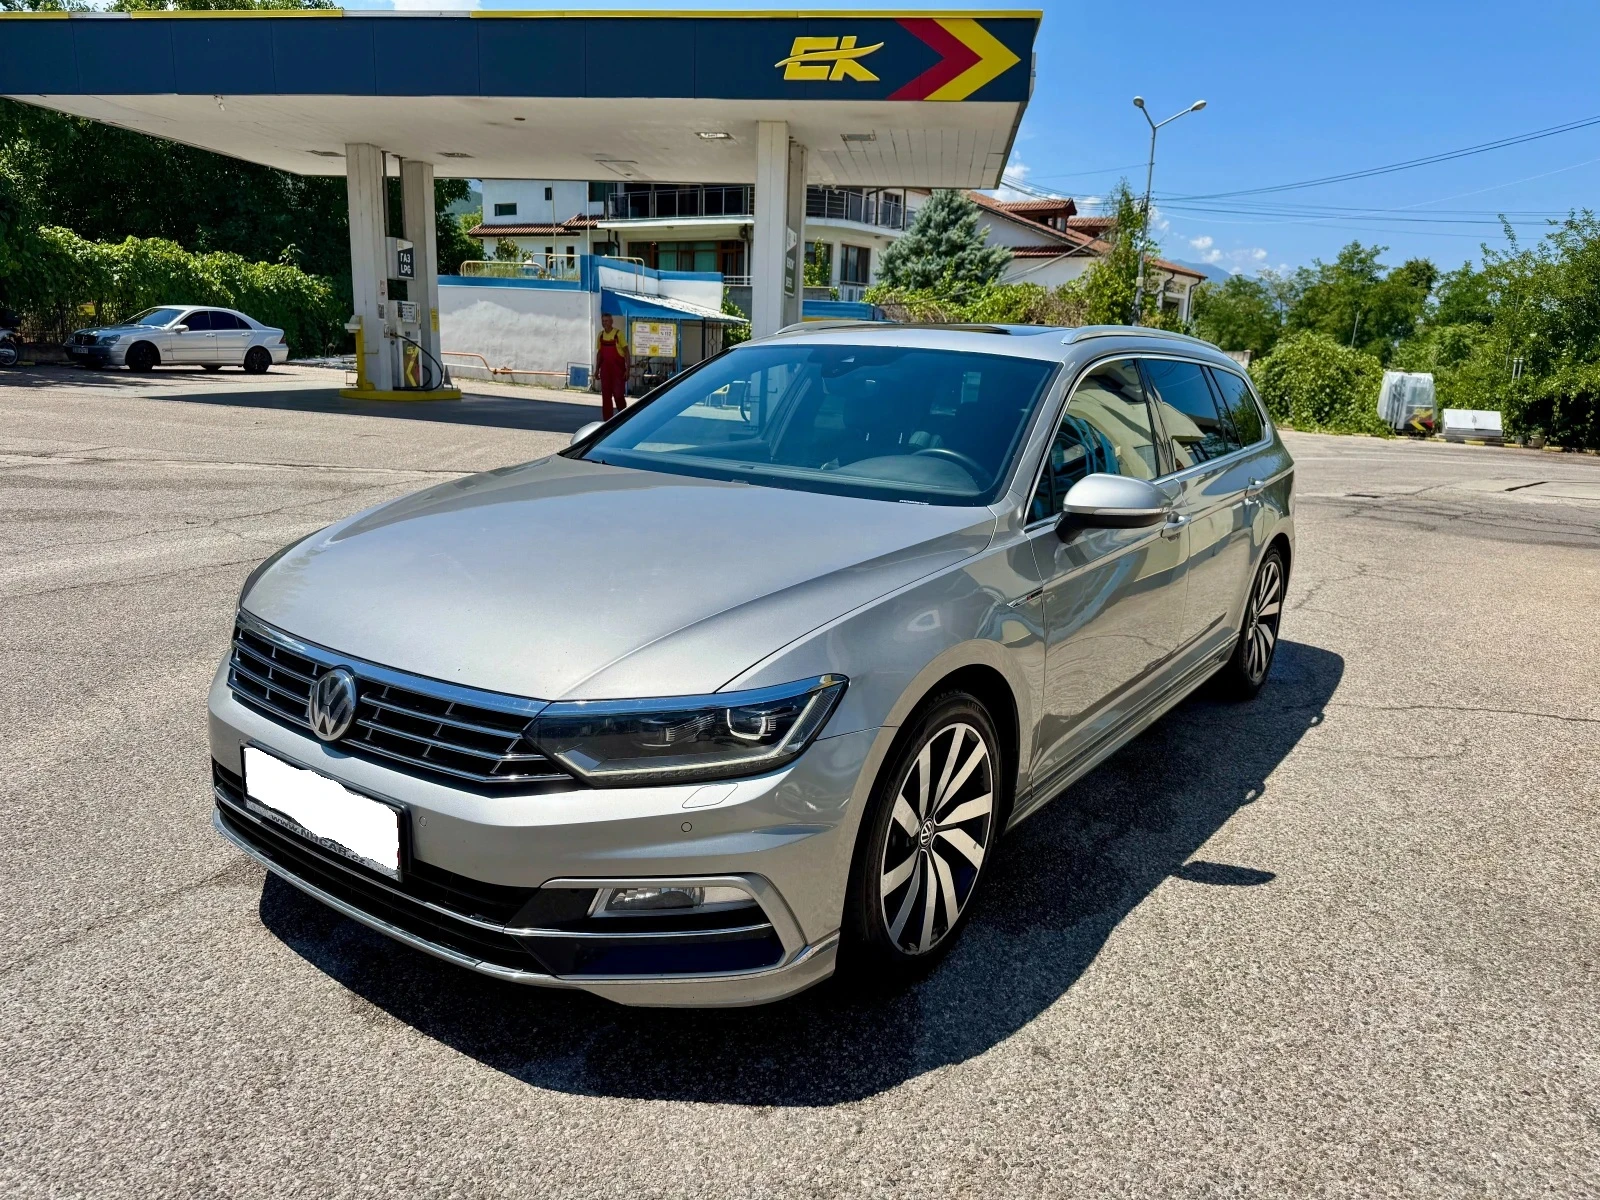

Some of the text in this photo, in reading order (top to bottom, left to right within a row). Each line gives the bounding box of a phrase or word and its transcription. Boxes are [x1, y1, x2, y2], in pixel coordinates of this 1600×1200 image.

[775, 36, 884, 81] EK
[400, 253, 411, 263] ГАЗ
[401, 263, 412, 274] LPG
